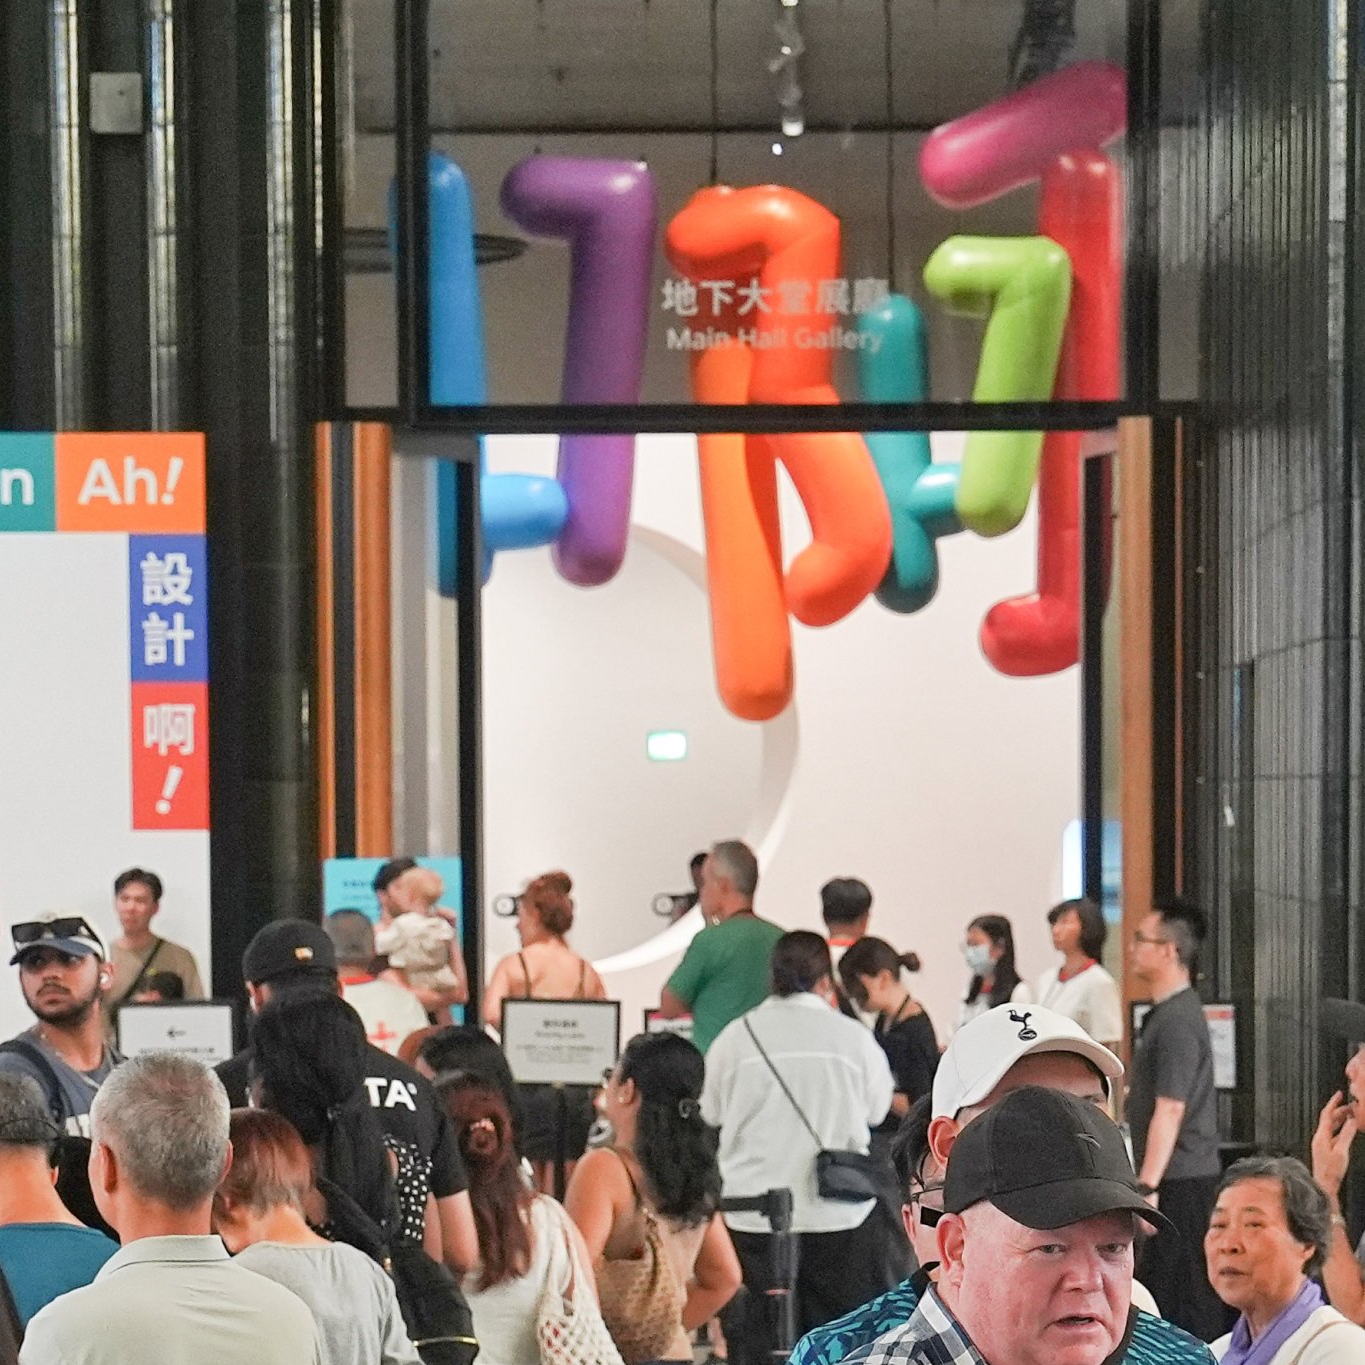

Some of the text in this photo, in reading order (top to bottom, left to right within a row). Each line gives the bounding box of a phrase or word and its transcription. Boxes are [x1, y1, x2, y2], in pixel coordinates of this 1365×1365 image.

[666, 328, 883, 354] Main Hall Gallery
[78, 457, 184, 505] Ah!
